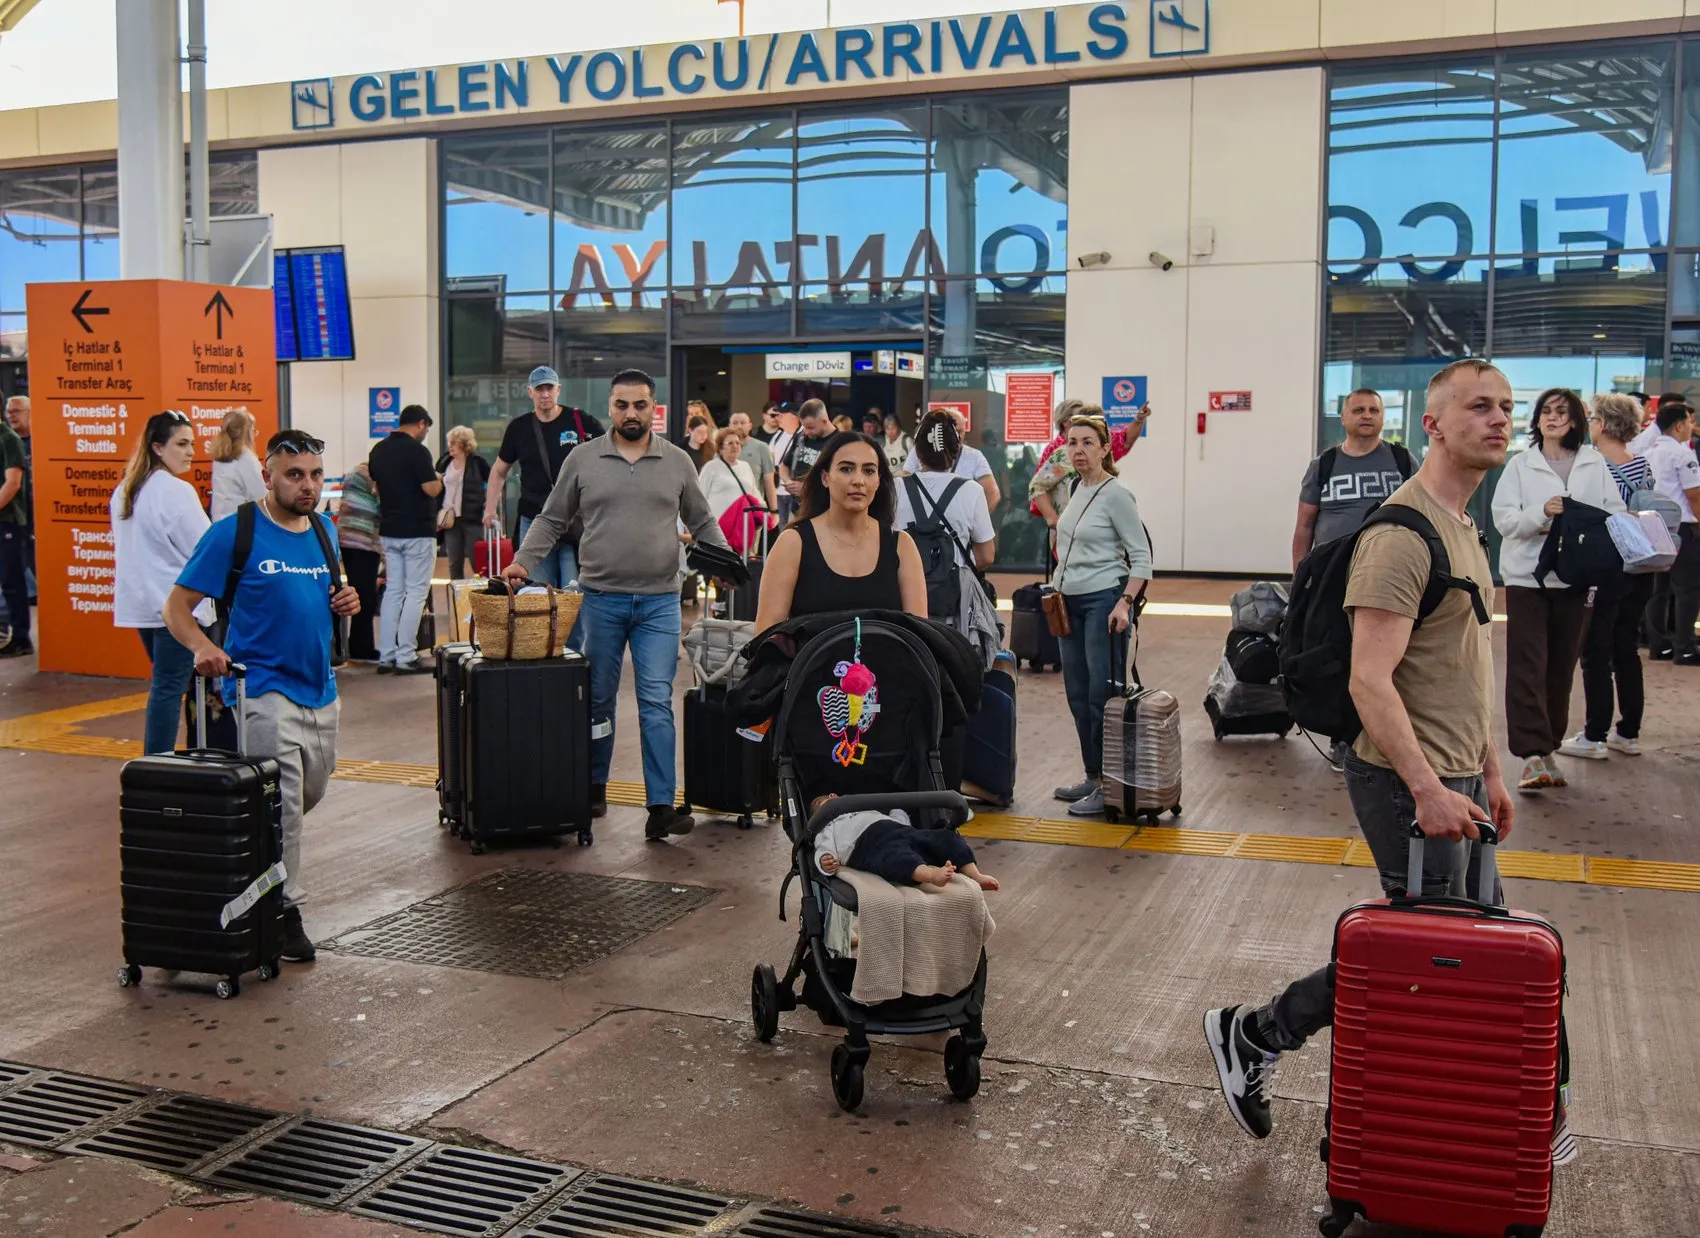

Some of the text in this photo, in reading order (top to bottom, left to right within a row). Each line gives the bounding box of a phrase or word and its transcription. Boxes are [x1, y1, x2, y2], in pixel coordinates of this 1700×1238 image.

[350, 1, 1128, 122] GELEN YOLCU/ARRIVALS
[63, 340, 122, 357] İç Hatlar &
[192, 340, 244, 358] İç Hatlar &
[66, 358, 123, 372] Terminal 1
[195, 360, 245, 375] Terminal 1
[772, 359, 845, 372] Change Döviz
[57, 377, 133, 392] Transfer Araç
[187, 378, 252, 394] Transfer Araç
[62, 403, 128, 418] Domestic &
[67, 421, 126, 436] Terminal 1
[76, 439, 117, 454] Shuttle
[65, 466, 118, 481] Domestic
